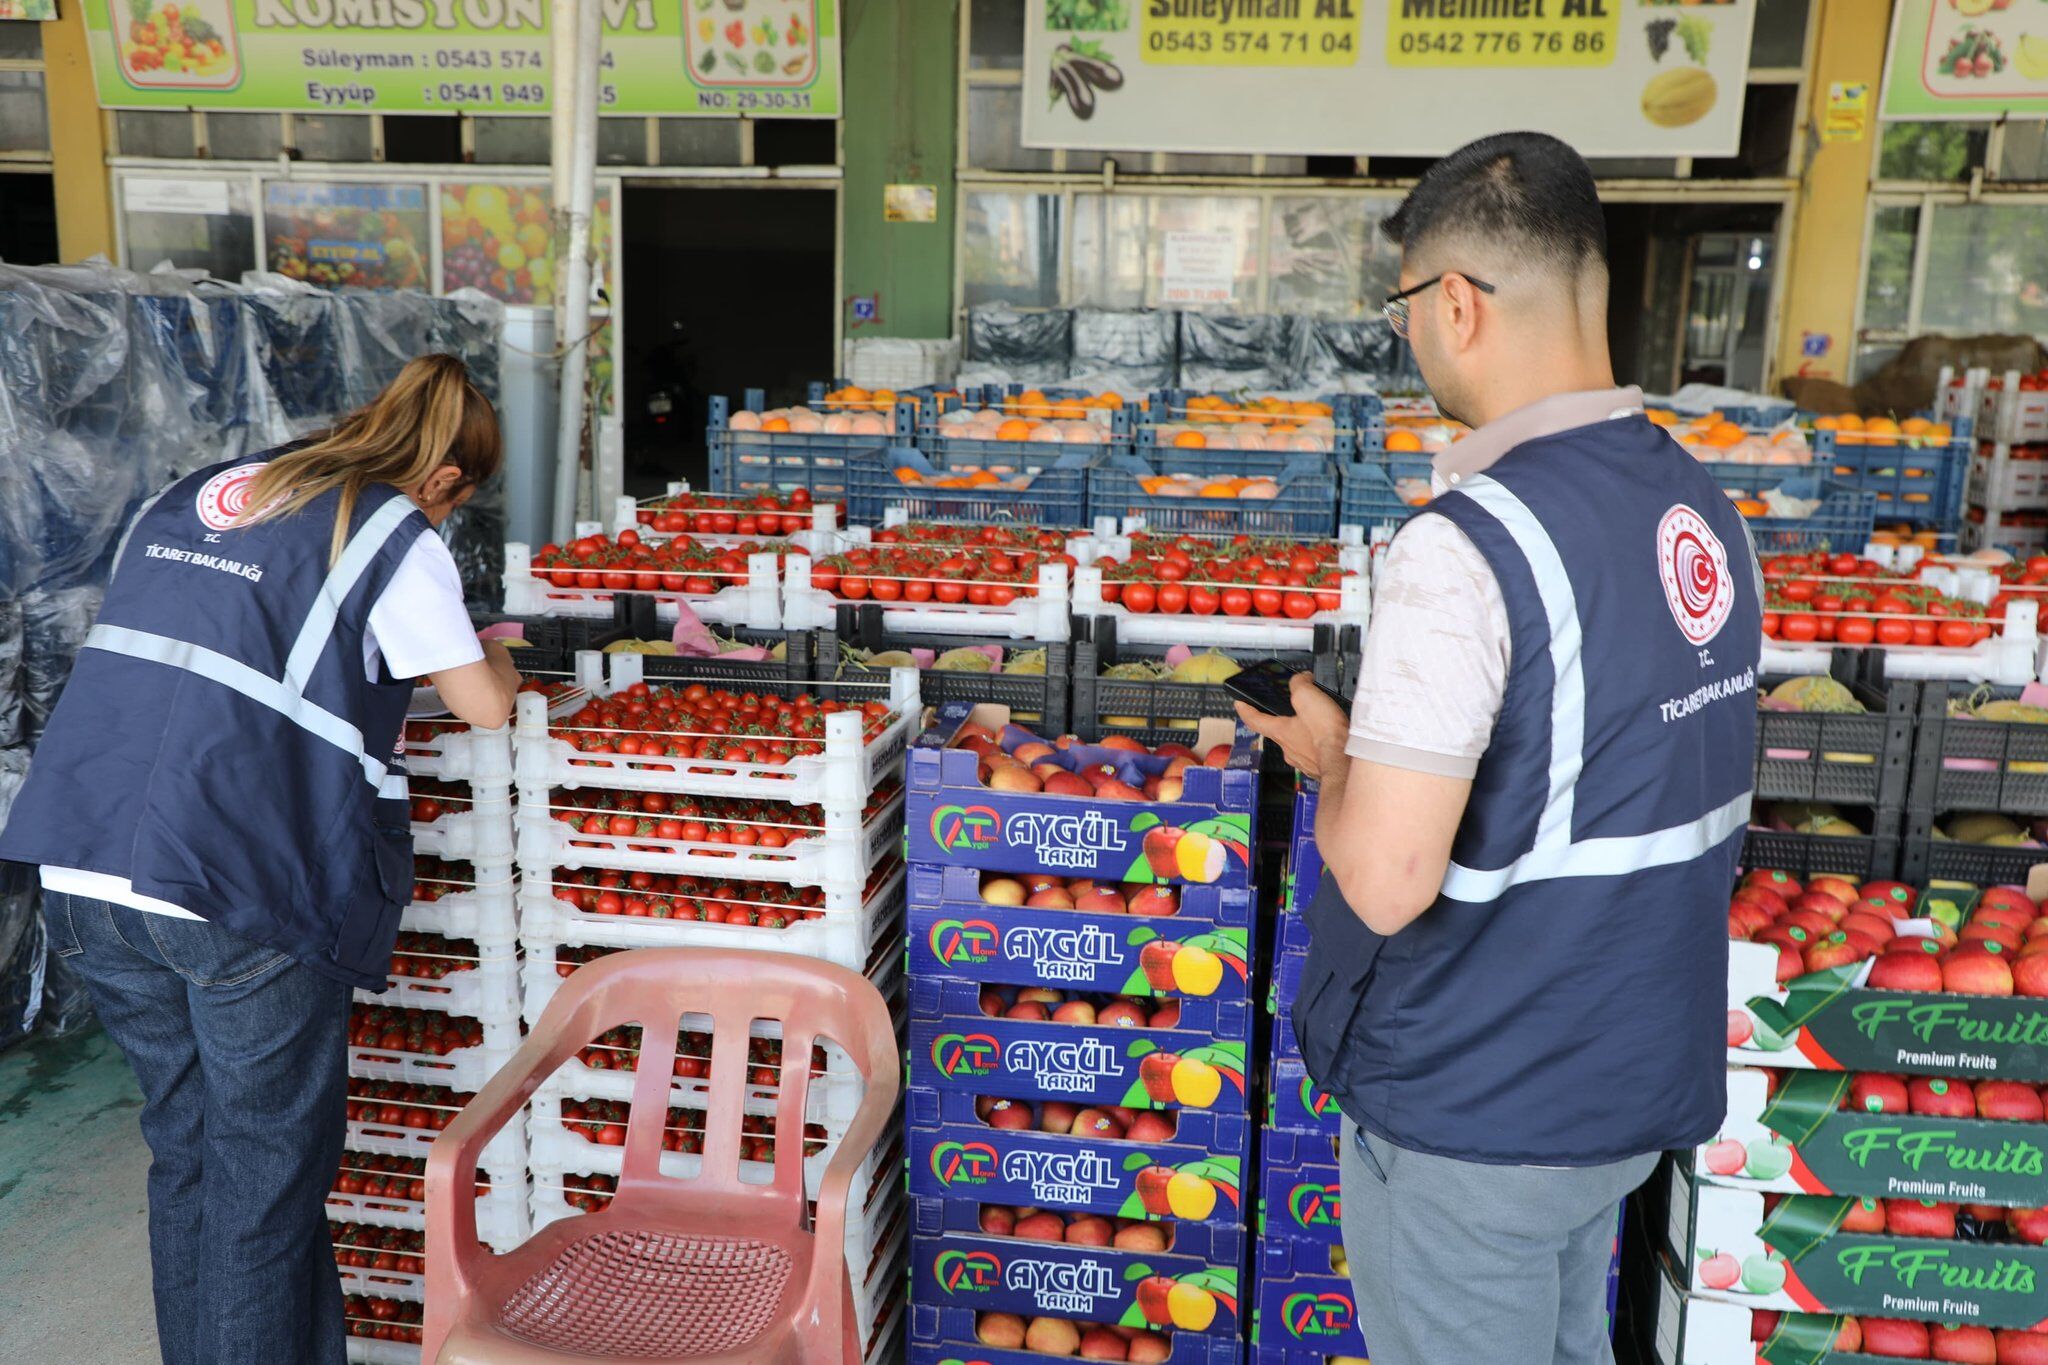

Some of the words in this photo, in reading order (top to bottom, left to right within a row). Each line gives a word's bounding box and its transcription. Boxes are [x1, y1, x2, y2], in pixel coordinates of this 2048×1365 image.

[1150, 31, 1212, 52] 0543
[1222, 32, 1269, 53] 574
[1281, 32, 1308, 53] 71
[1321, 32, 1353, 53] 04
[1401, 32, 1464, 53] 0542
[1474, 32, 1521, 53] 776
[1532, 32, 1562, 53] 76
[1573, 32, 1605, 53] 86
[302, 48, 414, 72] Süleyman
[436, 50, 493, 69] 0543
[500, 51, 542, 69] 574
[307, 82, 375, 104] Eyyüp
[440, 86, 493, 101] 0541
[503, 86, 544, 102] 949
[699, 93, 730, 107] NO:
[737, 92, 812, 108] 29-30-31
[145, 544, 193, 562] TİCARET
[191, 552, 263, 582] BAKANLIĞI
[1005, 811, 1127, 852] AYGÜL
[1037, 848, 1097, 868] TARIM
[1003, 925, 1125, 964] AYGÜL
[1034, 960, 1095, 981] TARIM
[1851, 999, 1913, 1040] F
[1005, 1038, 1124, 1076] AYGÜL
[1897, 1049, 1955, 1067] Premium
[1959, 1052, 1997, 1070] Fruits
[1034, 1072, 1095, 1093] TARIM
[1842, 1127, 1902, 1168] F
[1896, 1130, 2044, 1176] Fruits
[1002, 1150, 1120, 1188] AYGÜL
[1031, 1182, 1091, 1204] TARIM
[1888, 1176, 1945, 1195] Premium
[1948, 1180, 1986, 1198] Fruits
[1005, 1259, 1121, 1298] AYGÜL
[1837, 1245, 1895, 1285] F
[1890, 1249, 2037, 1294] Fruits
[1034, 1292, 1093, 1313] TARIM
[1883, 1293, 1939, 1313] Premium
[1943, 1298, 1980, 1316] Fruits
